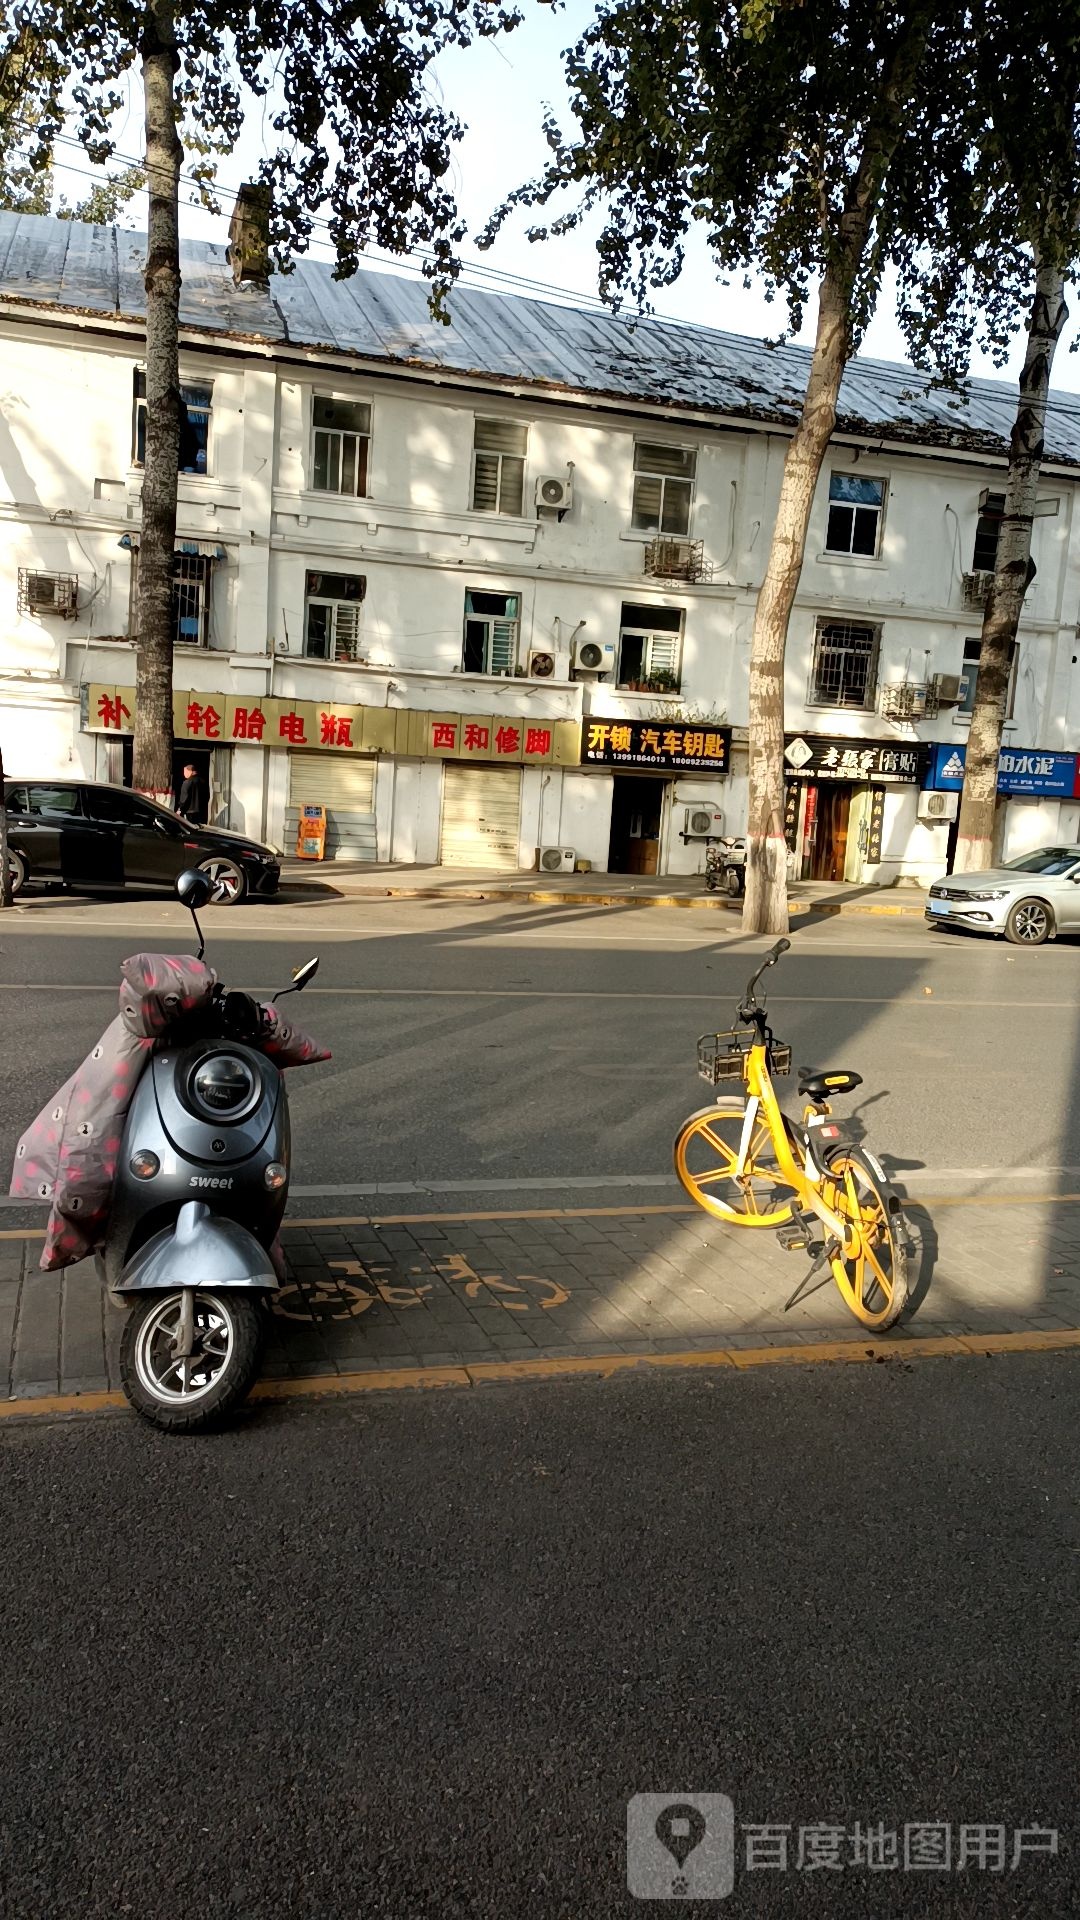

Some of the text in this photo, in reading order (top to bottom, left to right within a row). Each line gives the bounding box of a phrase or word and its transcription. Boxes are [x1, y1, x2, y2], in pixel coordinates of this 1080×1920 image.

[97, 693, 354, 748] 补轮胎电瓶
[432, 722, 551, 756] 西和修脚
[588, 724, 725, 758] 开锁 汽车钥匙
[883, 752, 918, 773] 膏贴
[189, 1176, 234, 1190] sweet
